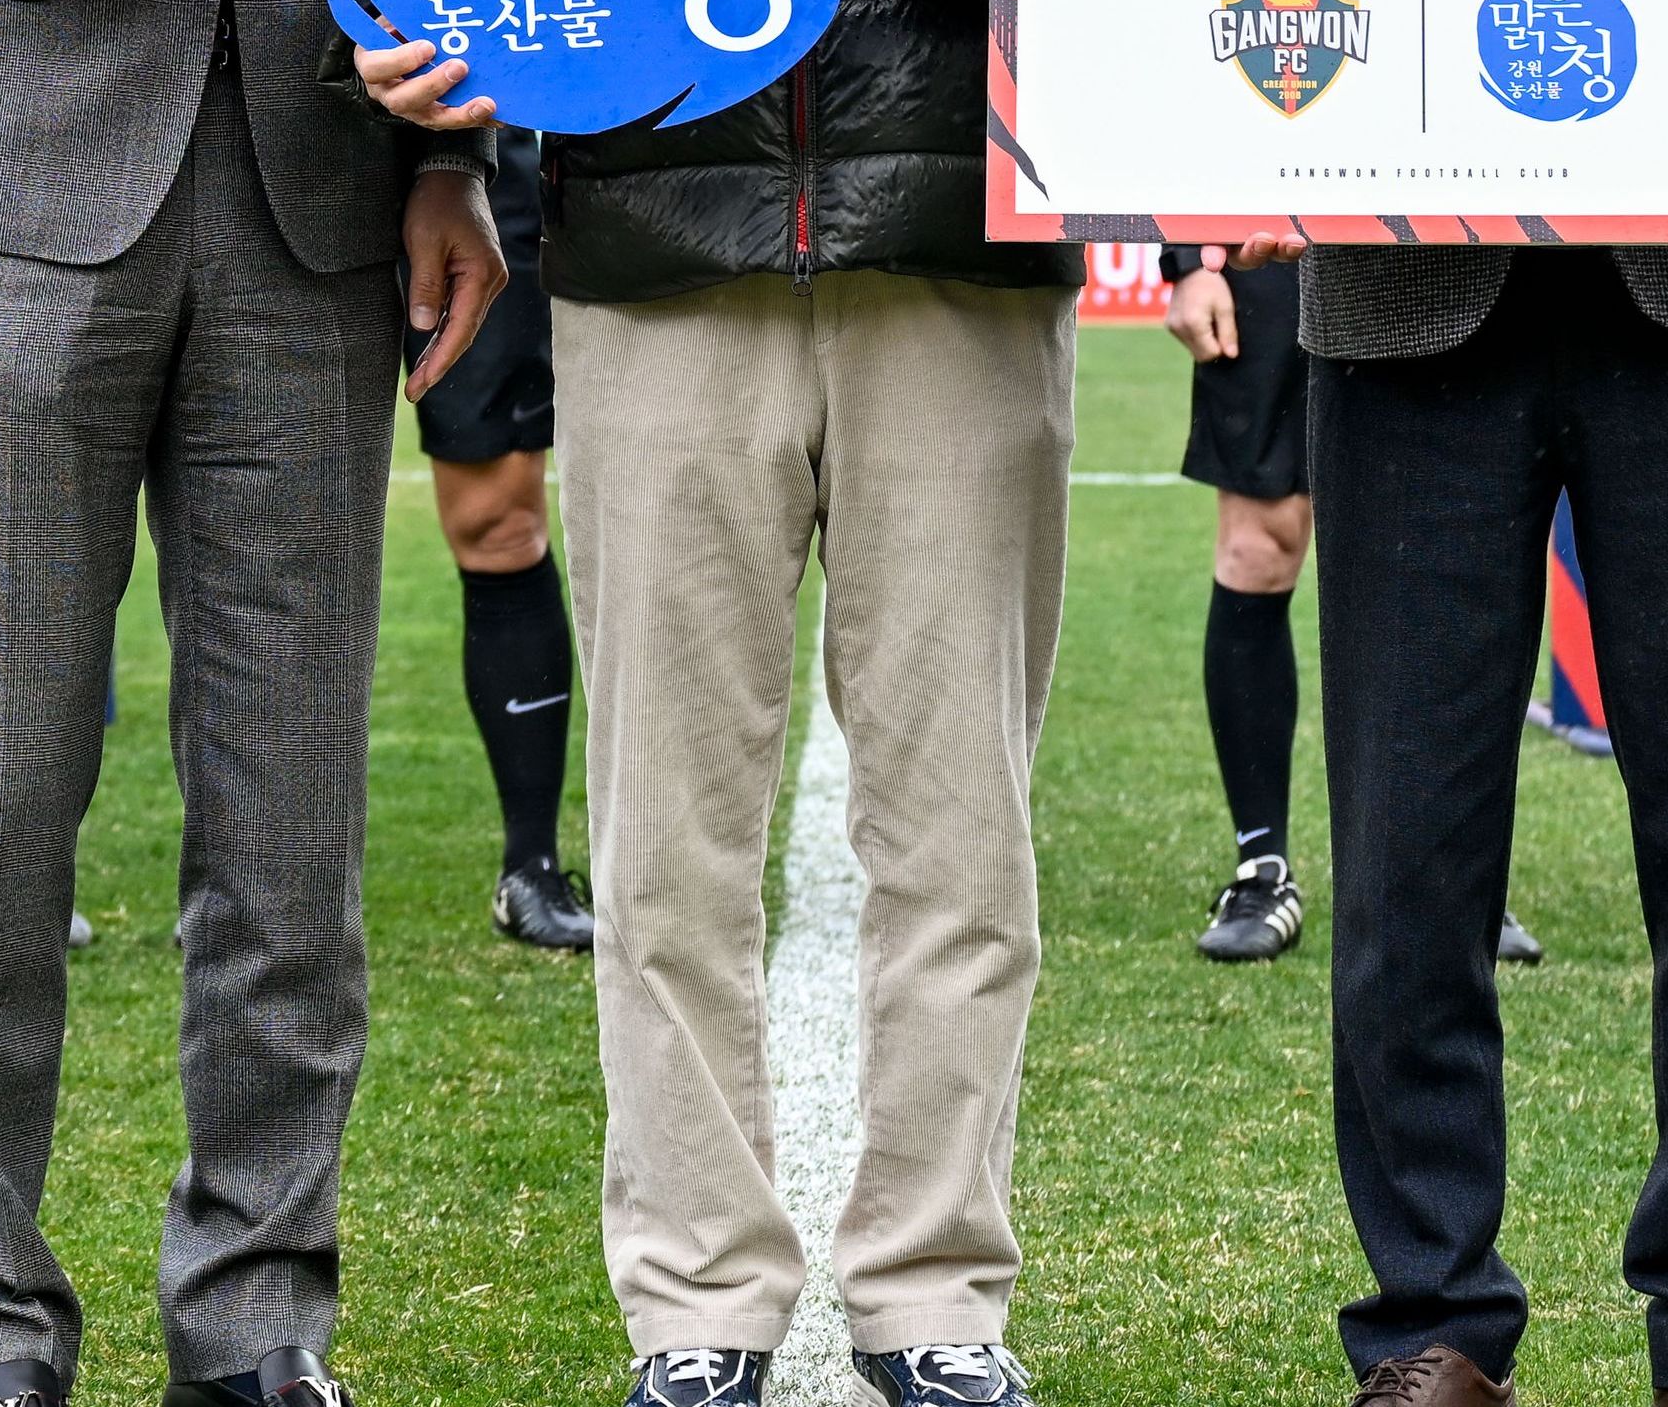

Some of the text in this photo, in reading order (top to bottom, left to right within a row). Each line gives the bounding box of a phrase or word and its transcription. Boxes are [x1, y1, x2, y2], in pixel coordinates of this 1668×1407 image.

[1209, 10, 1370, 63] GANGWON
[1273, 48, 1308, 74] FC
[1507, 60, 1543, 79] 강원
[1262, 79, 1318, 89] GREAT UNION
[1507, 81, 1564, 100] 농산물
[1278, 90, 1302, 100] 2008
[1280, 168, 1568, 178] GANGWON FOOTBALL CLUB
